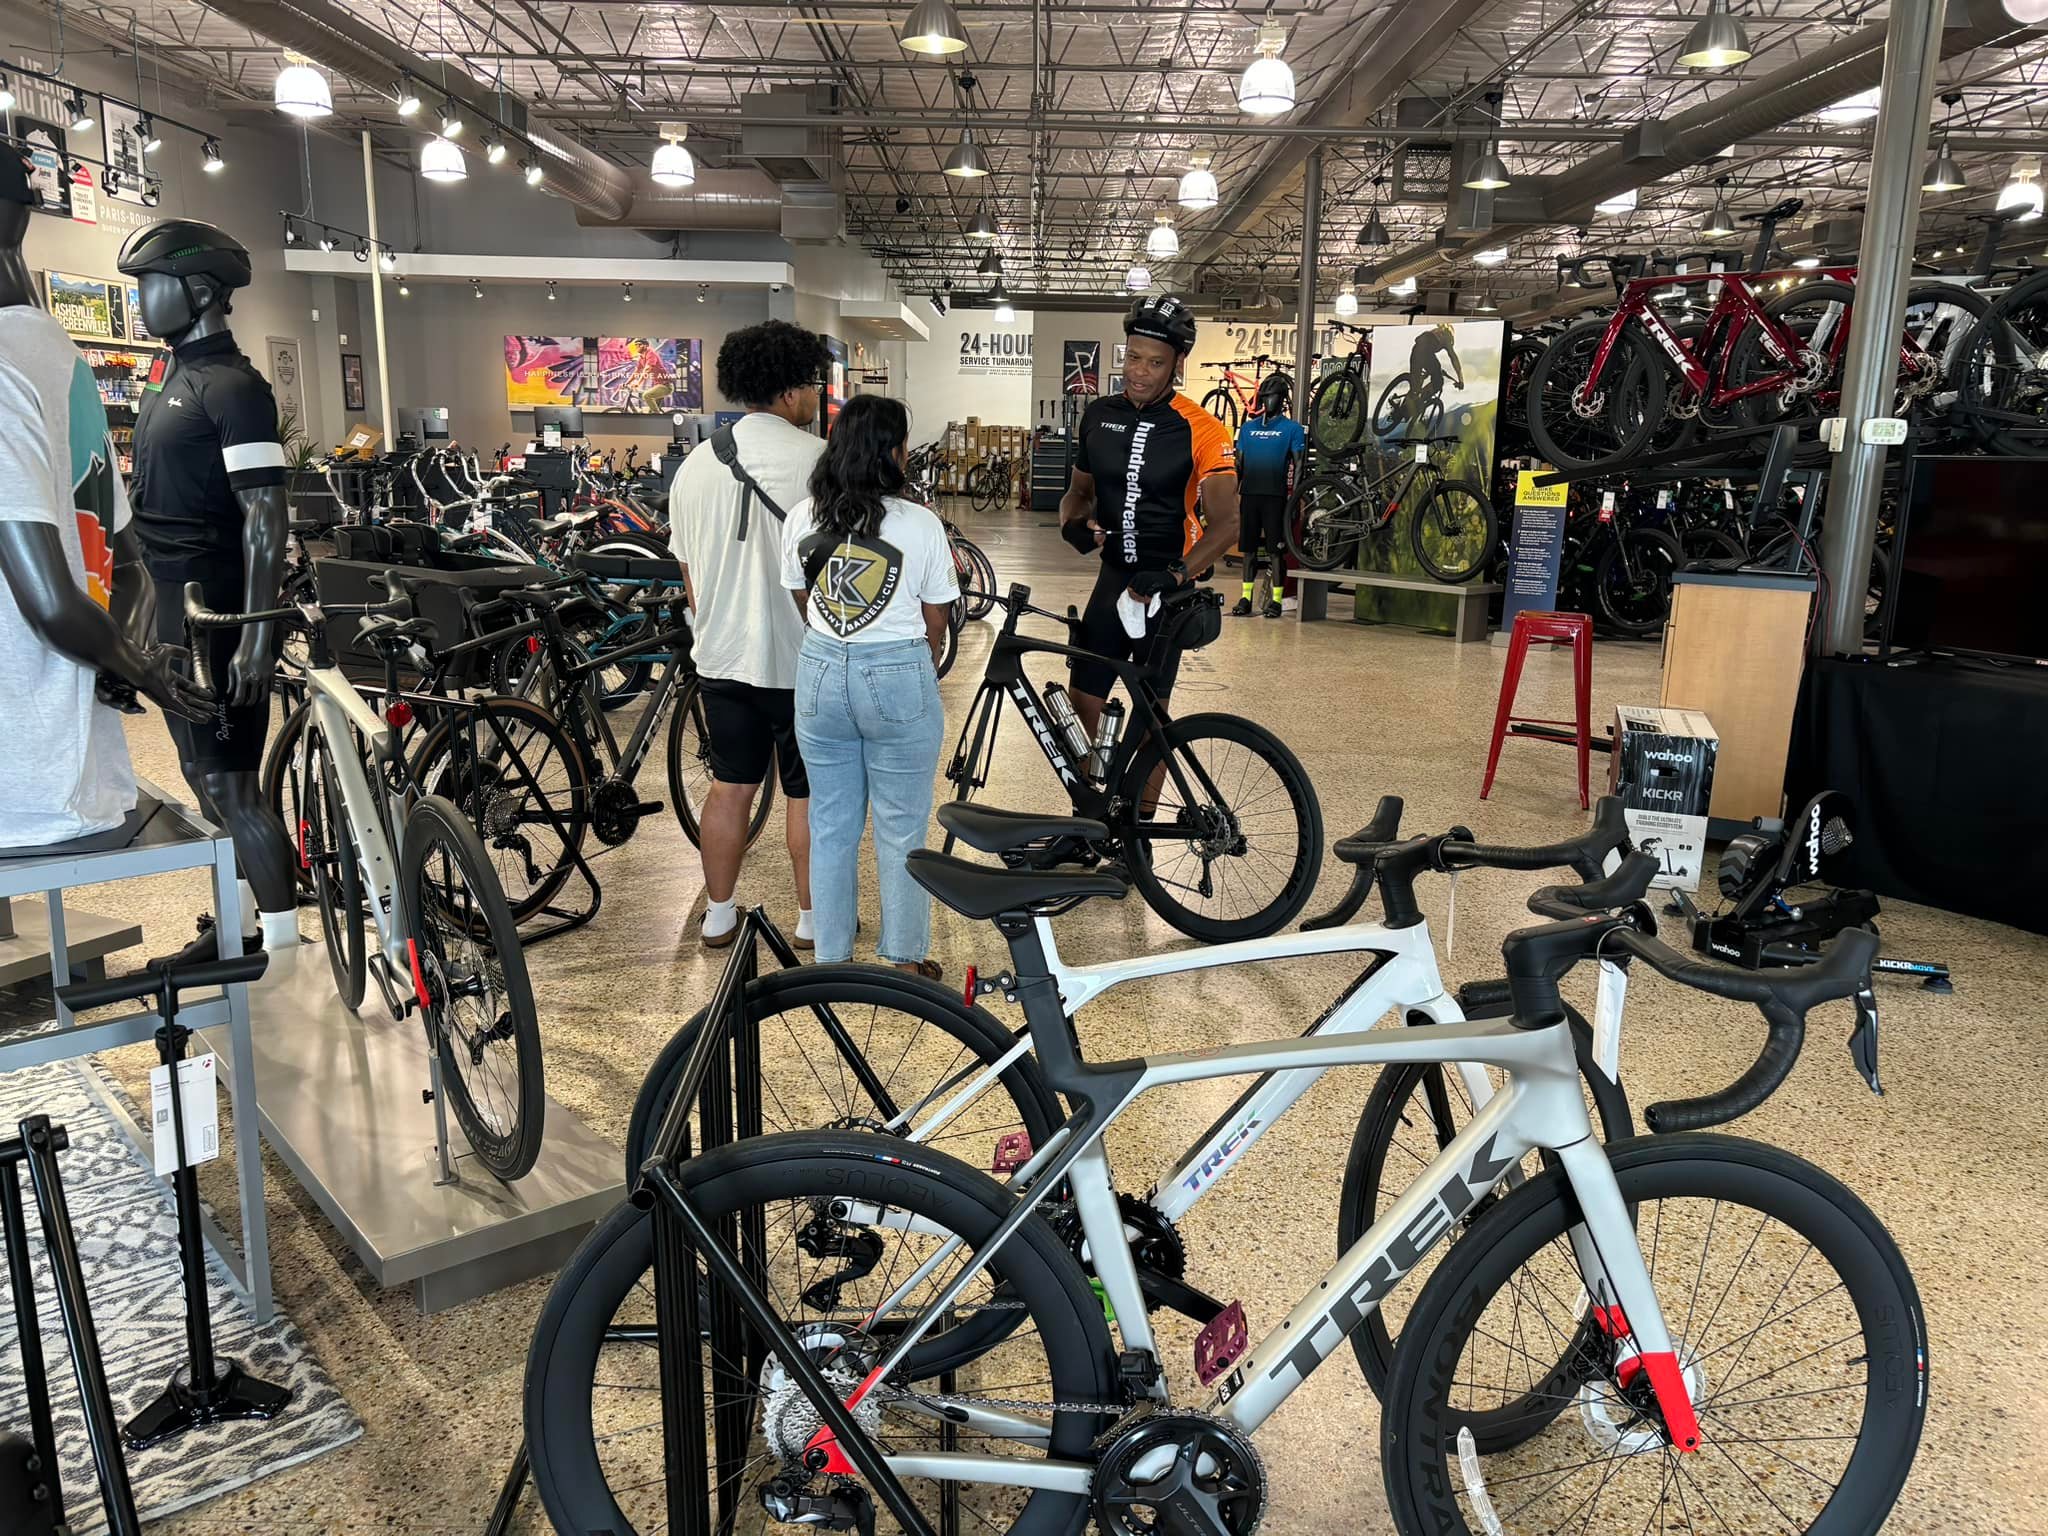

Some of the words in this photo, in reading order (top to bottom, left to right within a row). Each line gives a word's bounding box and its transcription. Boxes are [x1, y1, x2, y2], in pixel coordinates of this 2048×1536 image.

[40, 92, 74, 127] nor
[55, 302, 96, 320] ASHEVILLE
[63, 317, 110, 334] GREENVILLE
[1640, 305, 1695, 375] TREK
[524, 370, 573, 378] HAPPINESS
[960, 356, 990, 365] SERVICE
[992, 357, 1033, 367] TURNAROUN
[1101, 422, 1127, 430] TREK
[1122, 420, 1155, 564] hundredbreakers
[847, 599, 884, 631] BARBELL
[883, 566, 898, 595] CLUB
[1013, 678, 1078, 786] TREK
[1644, 749, 1693, 763] wahoo
[1642, 788, 1683, 801] KICKR
[1806, 803, 1821, 875] wahoo
[1711, 942, 1741, 958] wahoo
[1182, 1110, 1262, 1191] TREK
[1269, 1131, 1514, 1380] TREK
